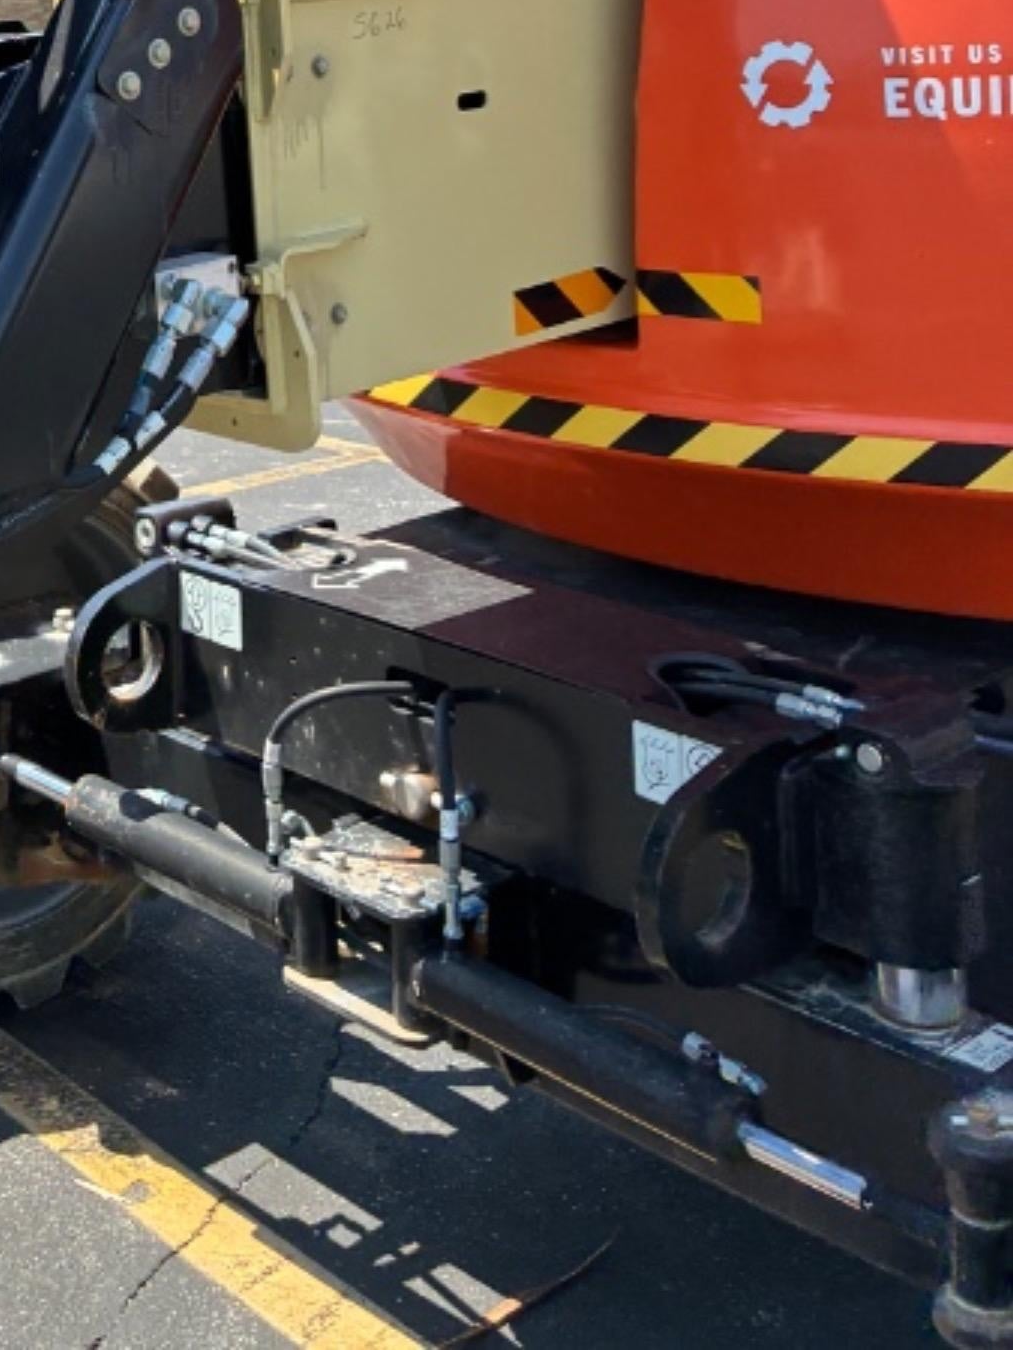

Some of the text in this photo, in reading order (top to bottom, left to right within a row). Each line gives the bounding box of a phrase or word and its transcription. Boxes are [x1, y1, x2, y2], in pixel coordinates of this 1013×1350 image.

[881, 44, 1002, 66] VISIT US
[884, 75, 1013, 120] EQUI
